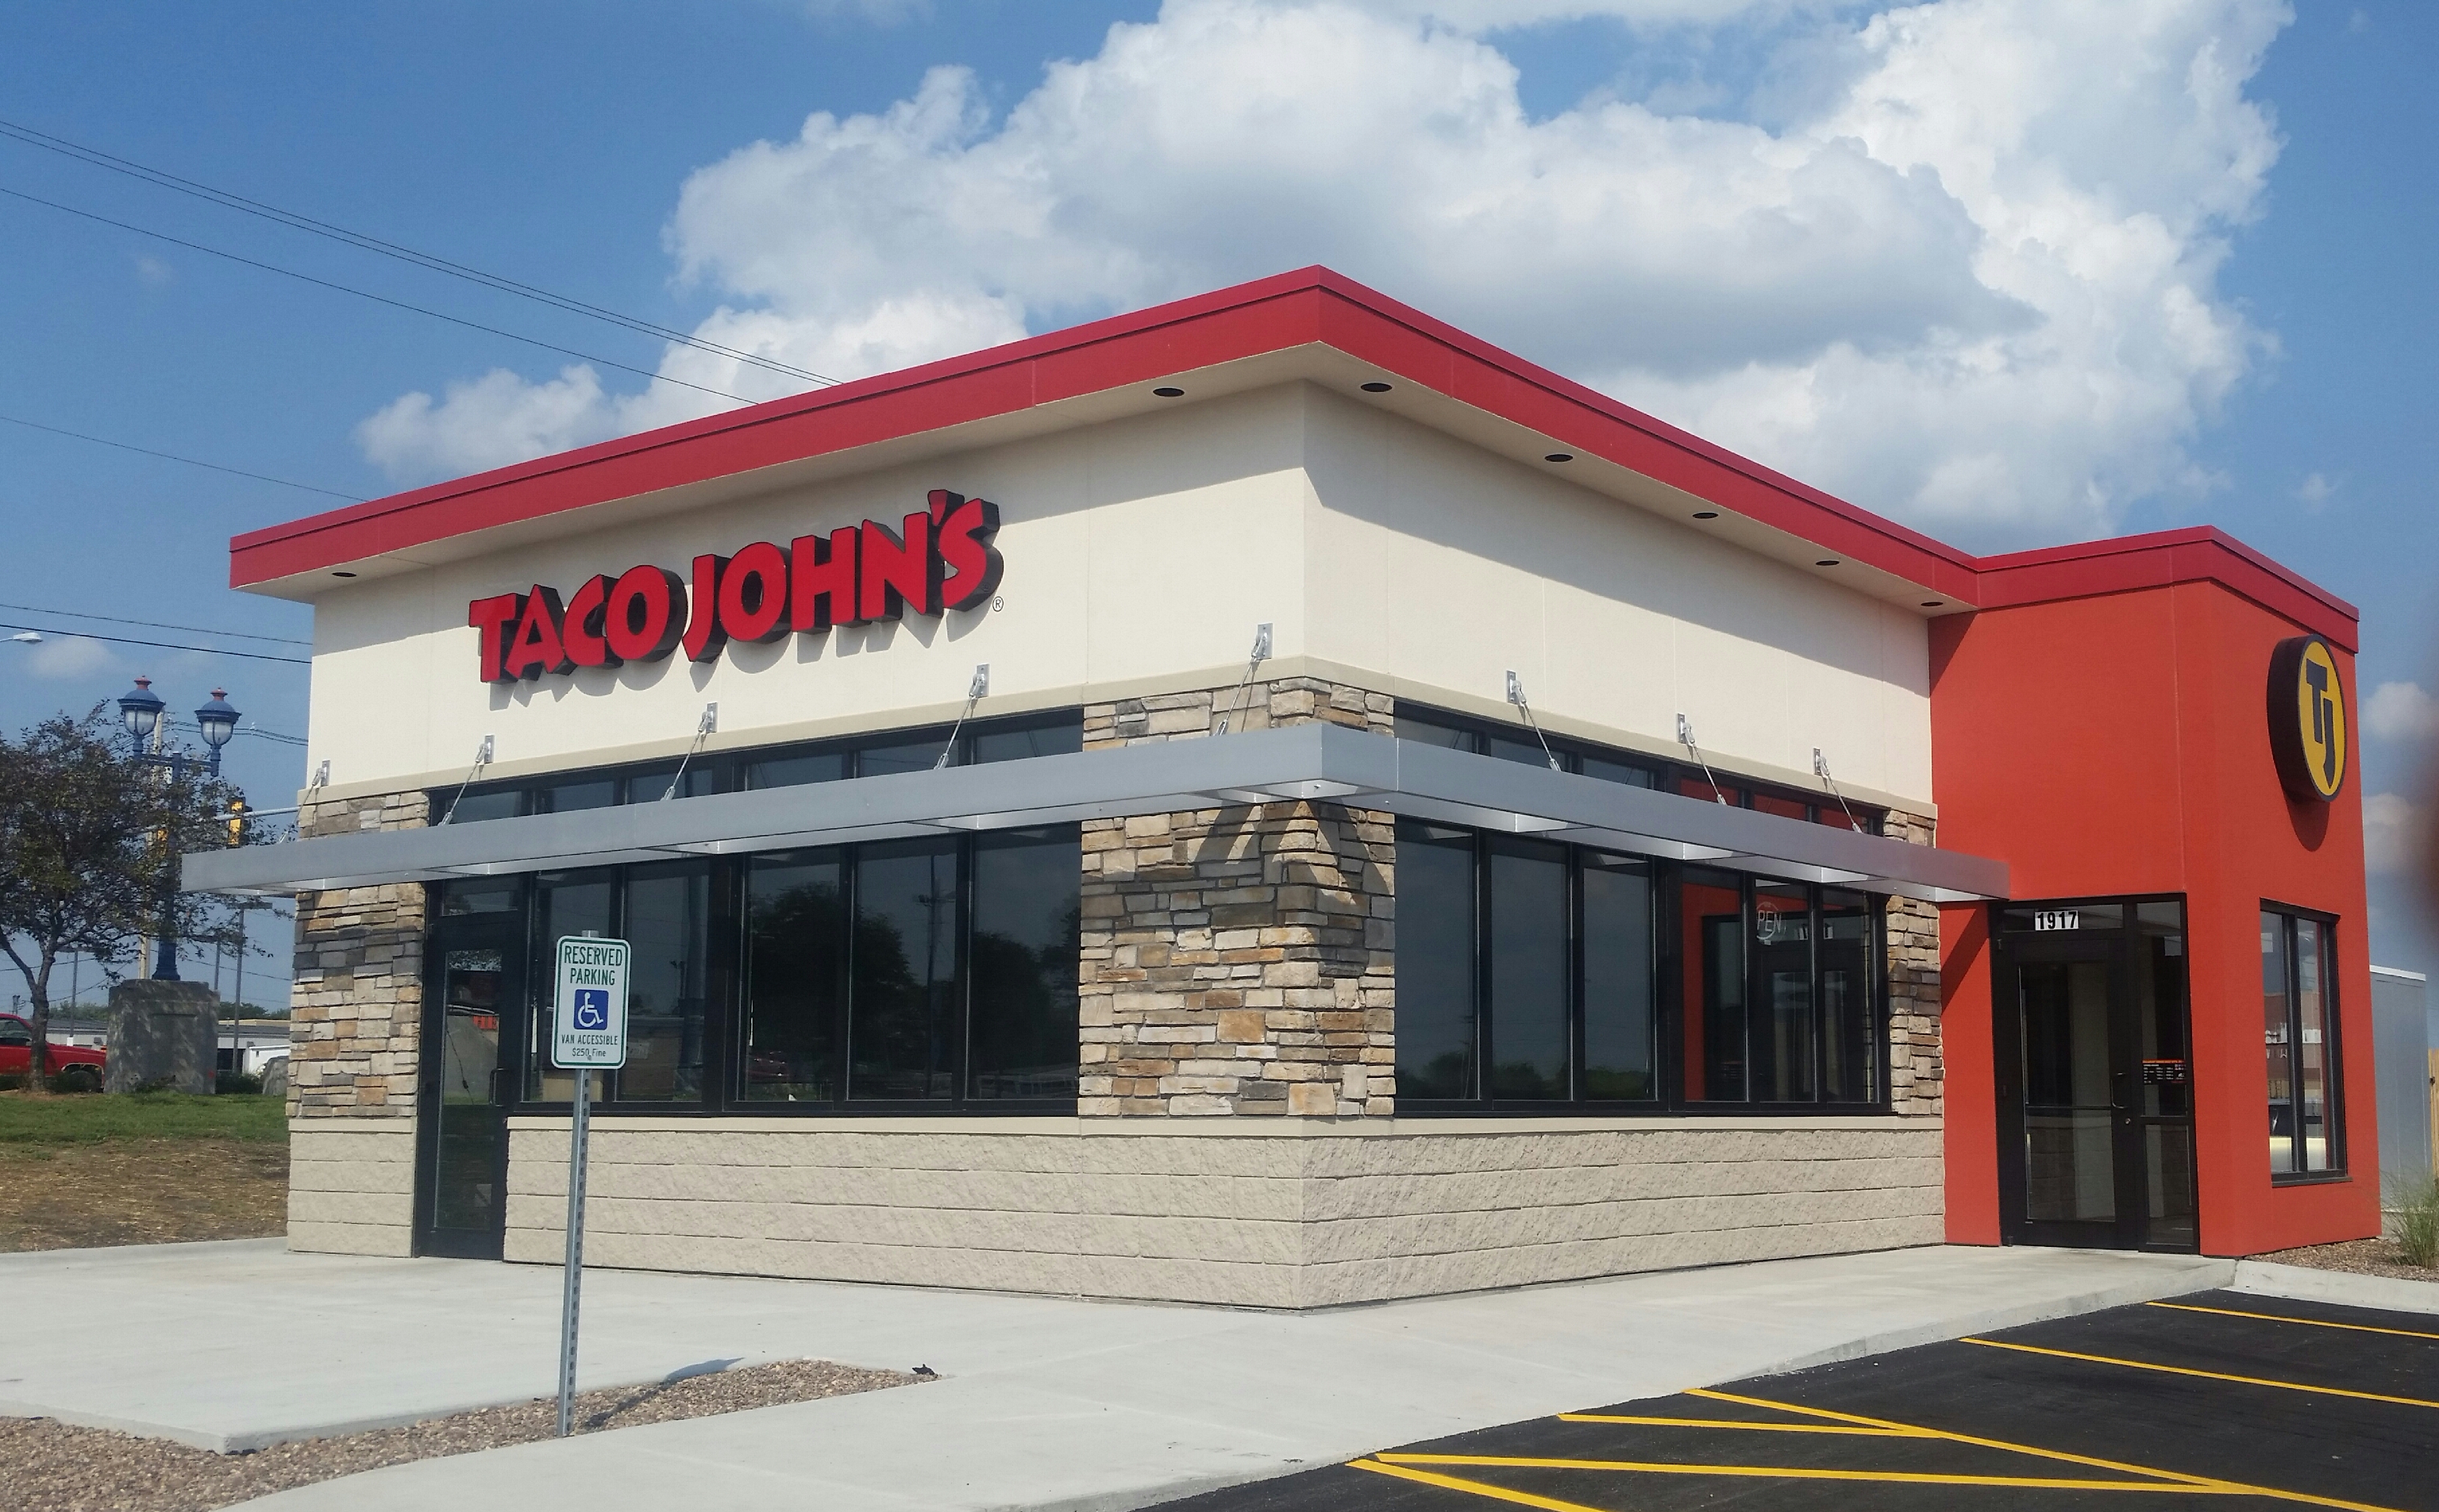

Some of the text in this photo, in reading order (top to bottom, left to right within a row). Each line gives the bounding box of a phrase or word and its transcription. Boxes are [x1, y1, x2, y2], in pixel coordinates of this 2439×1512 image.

[468, 564, 684, 683] TACO
[682, 489, 1003, 664] JOHN'S
[2306, 658, 2336, 789] TJ
[2037, 910, 2077, 929] 1917
[564, 945, 623, 967] RESERVED
[569, 968, 615, 986] PARKING
[561, 1034, 618, 1045] VAN ACCESSIBLE
[572, 1048, 607, 1057] $250 Fine
